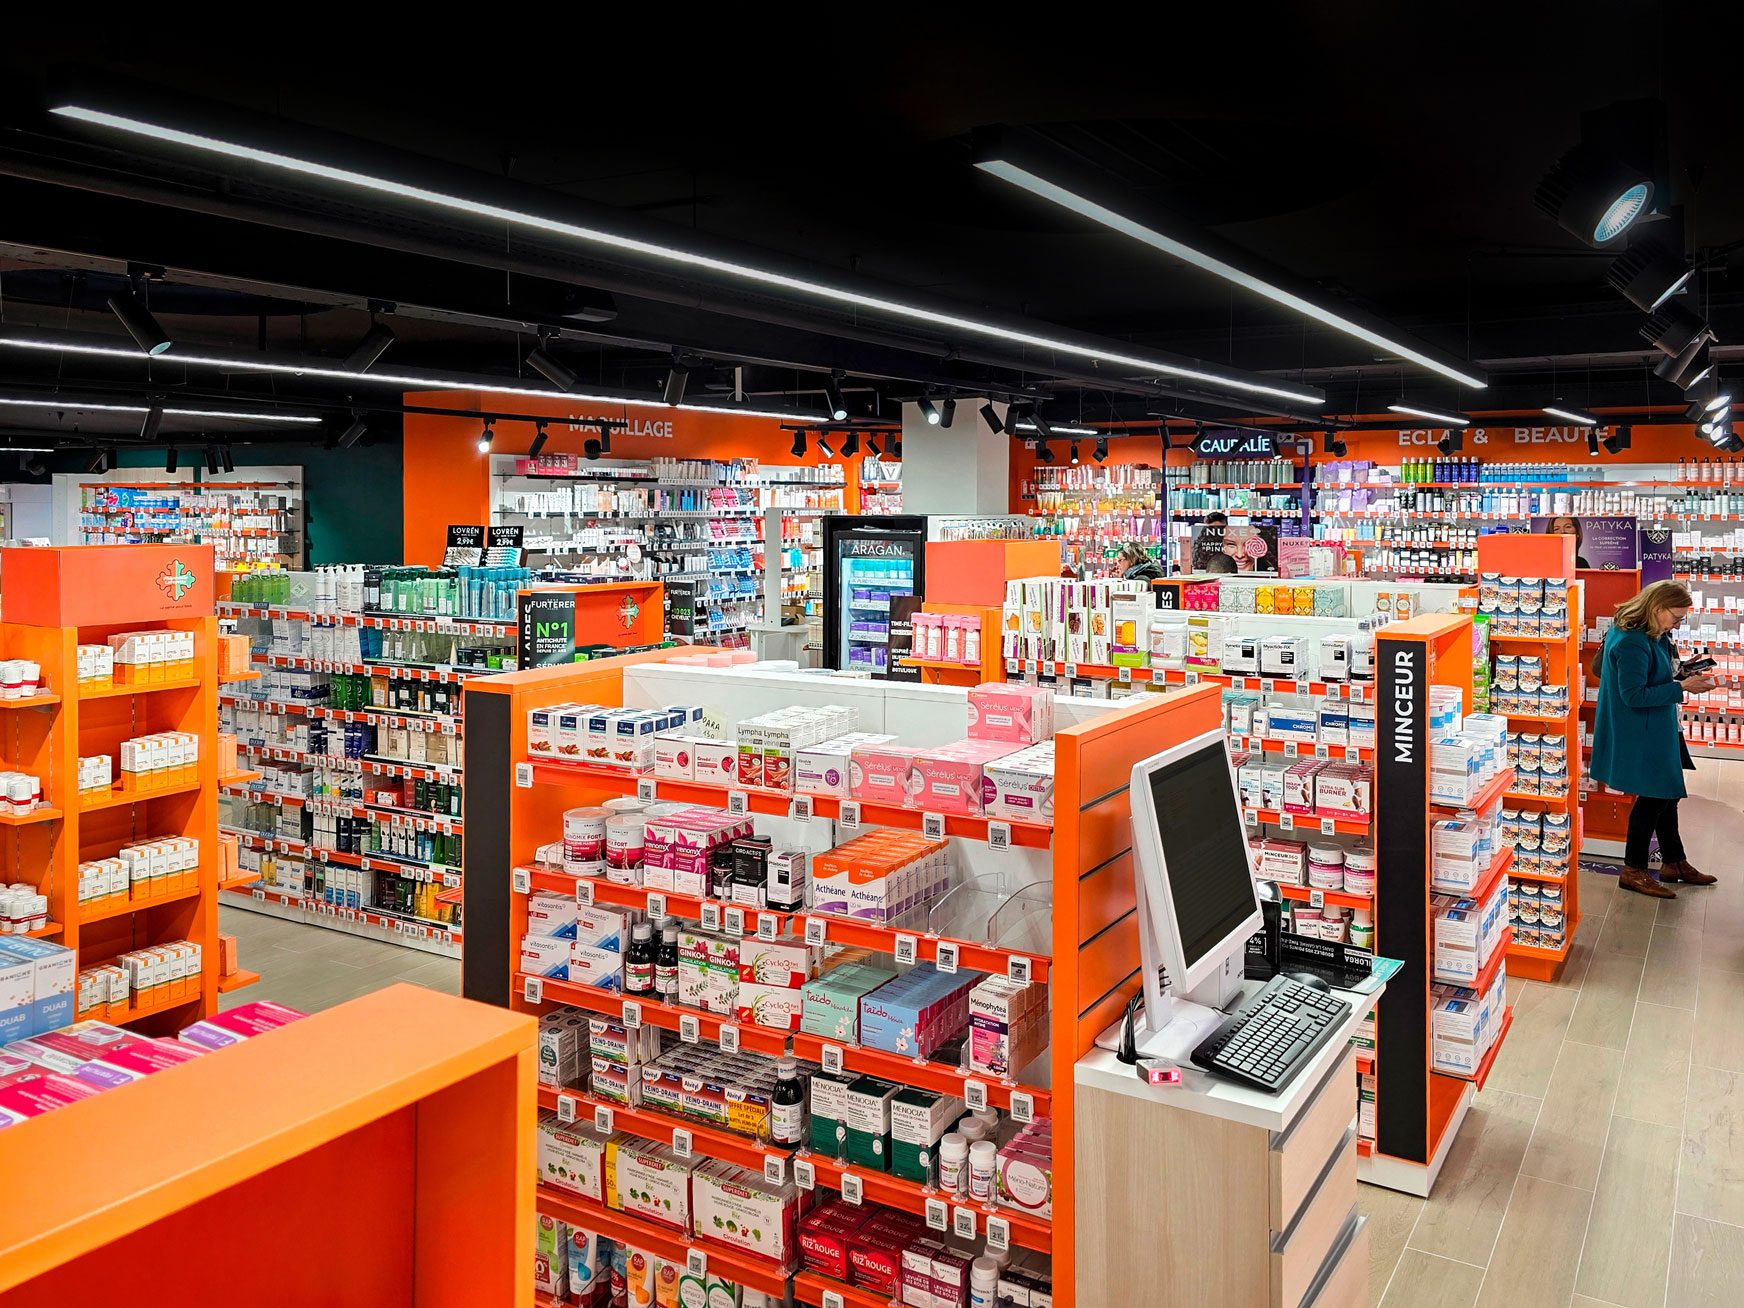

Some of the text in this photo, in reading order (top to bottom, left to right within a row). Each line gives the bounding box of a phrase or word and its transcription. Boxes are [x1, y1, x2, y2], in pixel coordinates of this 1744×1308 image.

[1399, 429, 1467, 446] ECLA
[1473, 428, 1488, 444] &
[492, 527, 519, 535] LOVRÉN
[1586, 520, 1632, 530] PATYKA
[1206, 528, 1250, 536] NUXE
[537, 622, 568, 637] N°1
[980, 702, 1008, 712] Sérélys
[1395, 652, 1413, 764] MINCEUR
[738, 727, 761, 736] Lympha
[764, 730, 789, 739] Lympha
[864, 761, 890, 772] Sérélys
[926, 768, 954, 780] Sérélys
[998, 778, 1027, 791] Sérélys
[816, 884, 846, 896] Acthéane
[851, 890, 882, 903] Acthéane
[680, 949, 706, 960] GINKO+
[709, 956, 735, 967] GINKO+
[806, 990, 831, 1007] taïdo
[43, 1001, 67, 1013] DUAB
[863, 1001, 888, 1018] taïdo
[592, 1036, 625, 1051] VEINO-DRAINE
[644, 1070, 658, 1080] Alvityl
[594, 1075, 625, 1090] VEINO-DRAINE
[684, 1081, 700, 1090] Alvityl
[644, 1086, 680, 1099] VEINO-DRAINE
[727, 1091, 742, 1101] Alvityl
[685, 1095, 722, 1110] VEINO-DRAINE
[847, 1094, 876, 1106] MÉNOCIA
[893, 1104, 924, 1117] MÉNOCIA
[555, 1134, 578, 1145] SUPERDIET
[638, 1158, 663, 1169] SUPERDIET
[722, 1185, 748, 1197] SUPERDIET
[723, 1234, 751, 1246] Circulation
[802, 1240, 839, 1258] RIZ ROUGE
[853, 1256, 892, 1274] RIZ ROUGE
[934, 1285, 950, 1294] LEVURE
